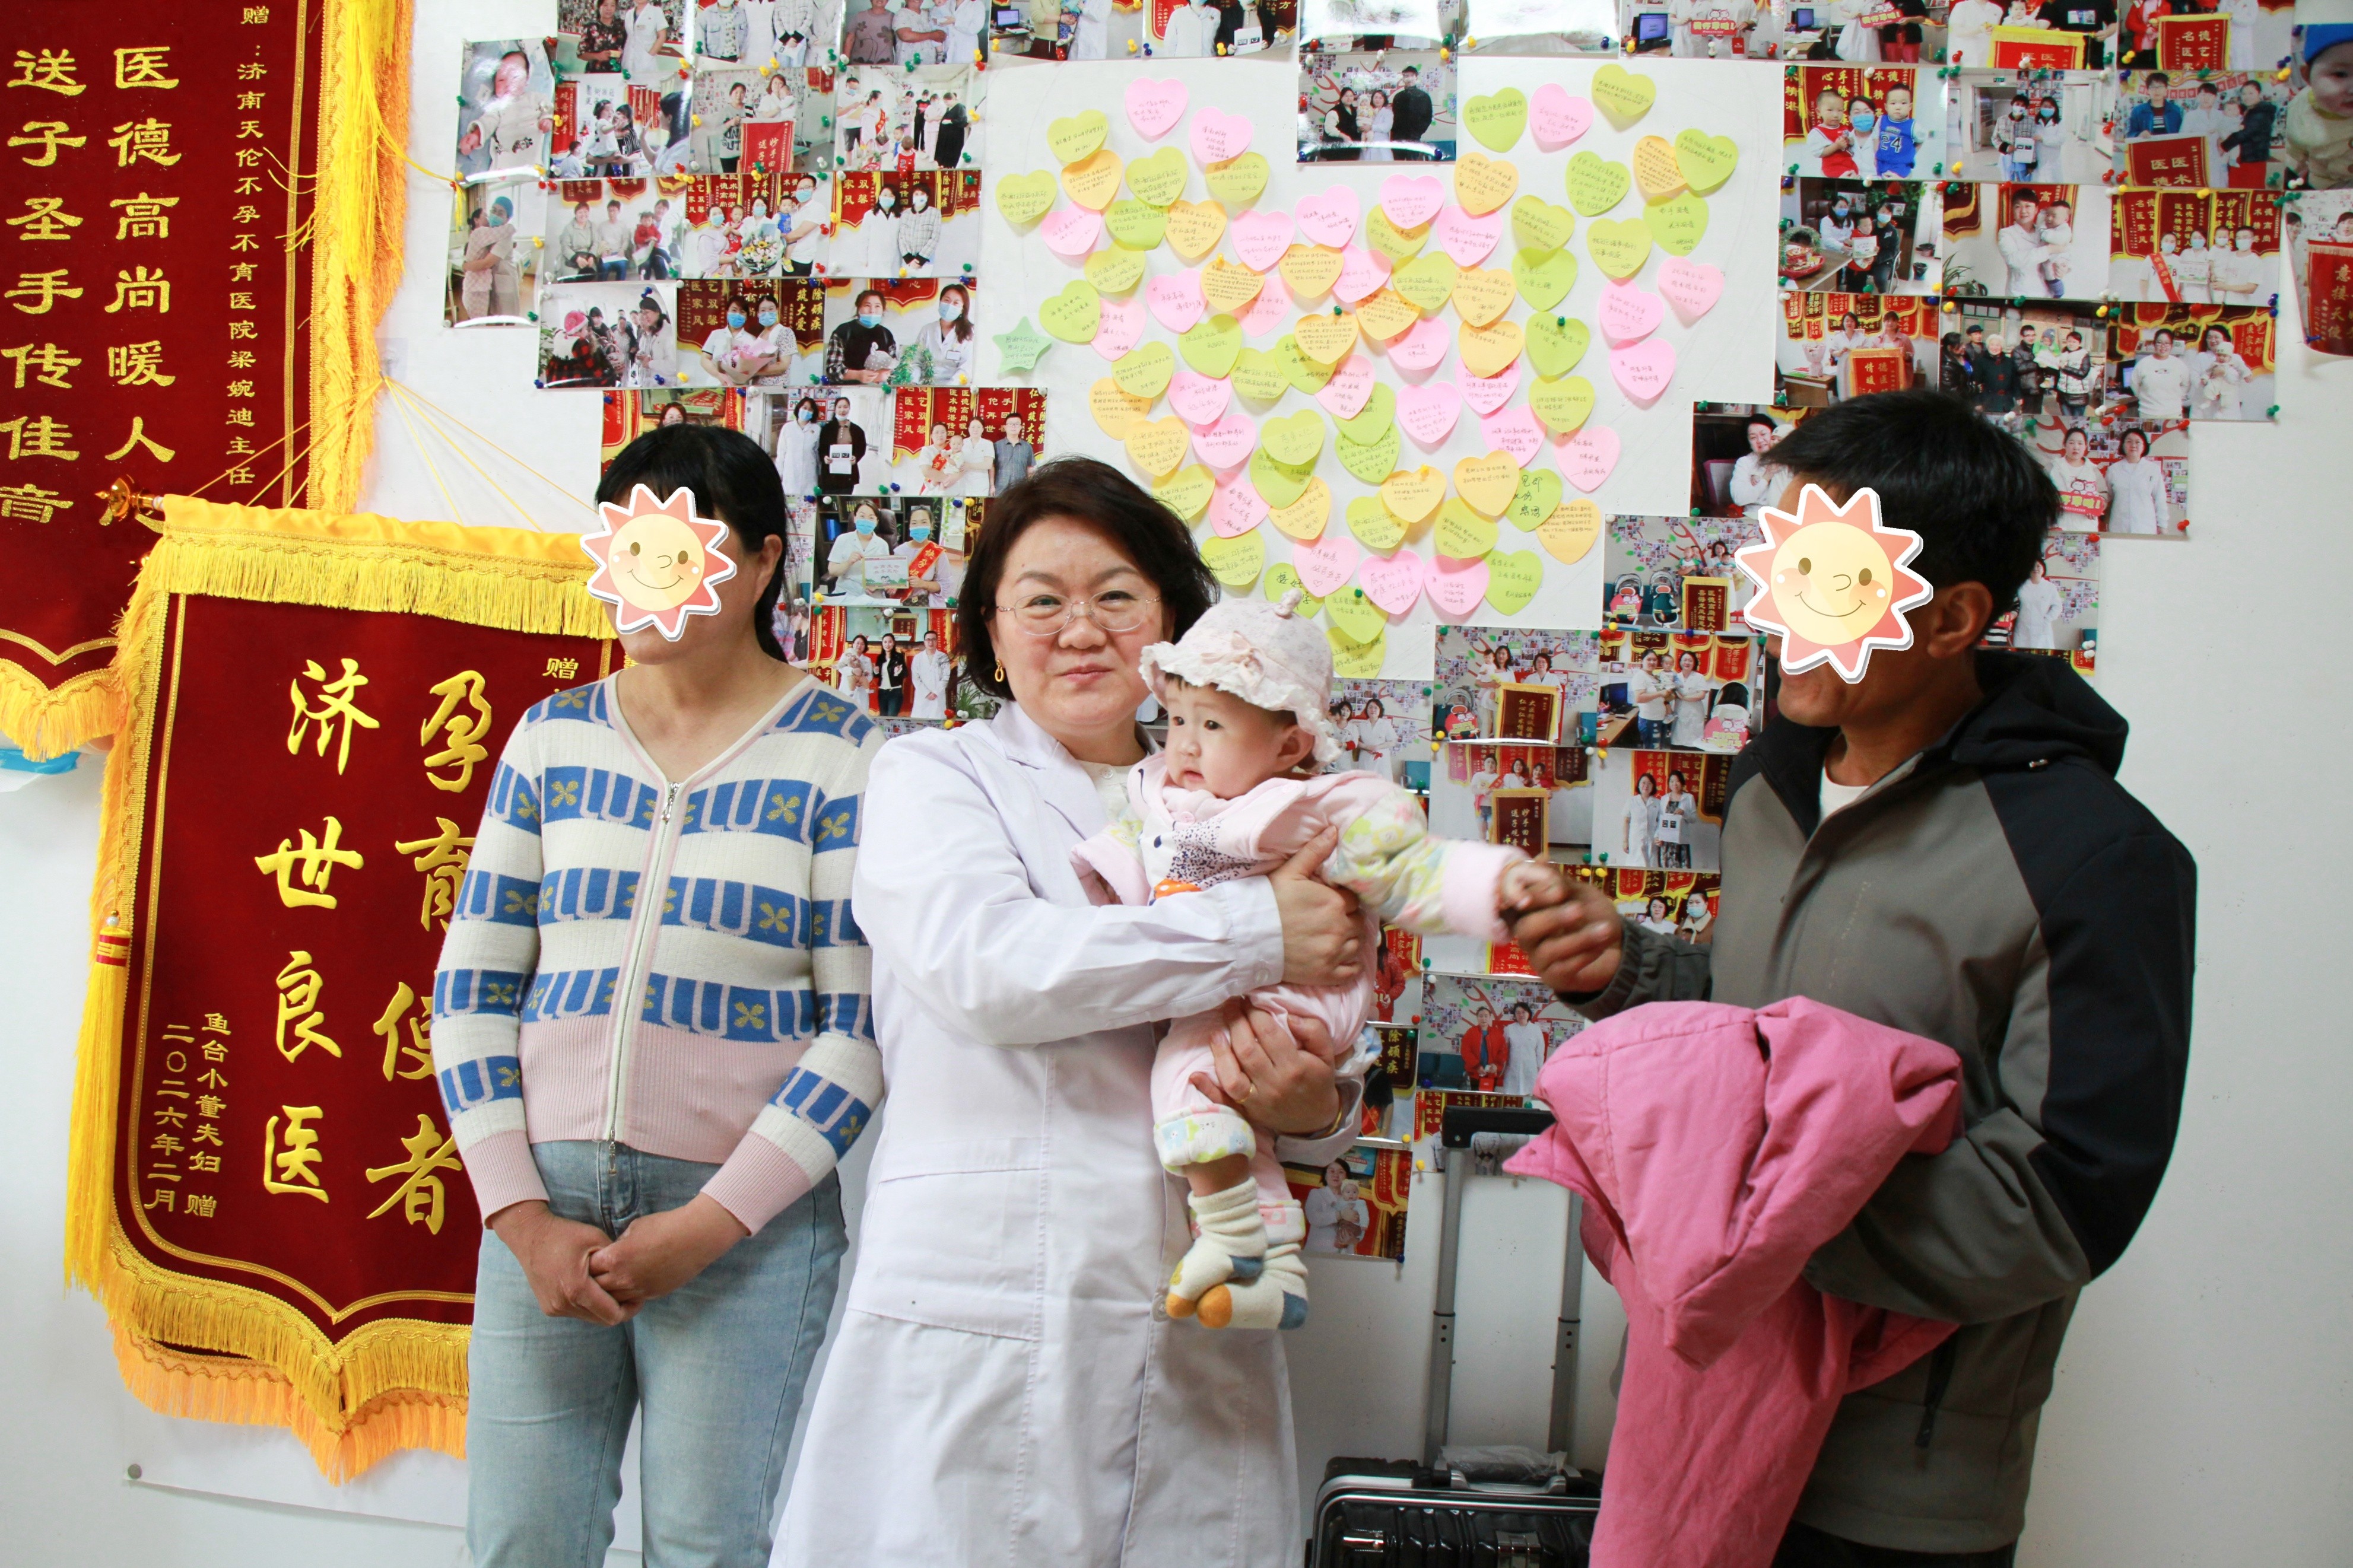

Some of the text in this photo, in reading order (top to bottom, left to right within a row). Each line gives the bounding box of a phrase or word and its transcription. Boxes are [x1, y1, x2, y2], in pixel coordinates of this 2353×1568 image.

[0, 49, 87, 523] 送子圣手传佳音
[99, 46, 182, 534] 医德高尚暖人
[1879, 135, 1903, 153] 24
[255, 659, 380, 1204] 济世良医
